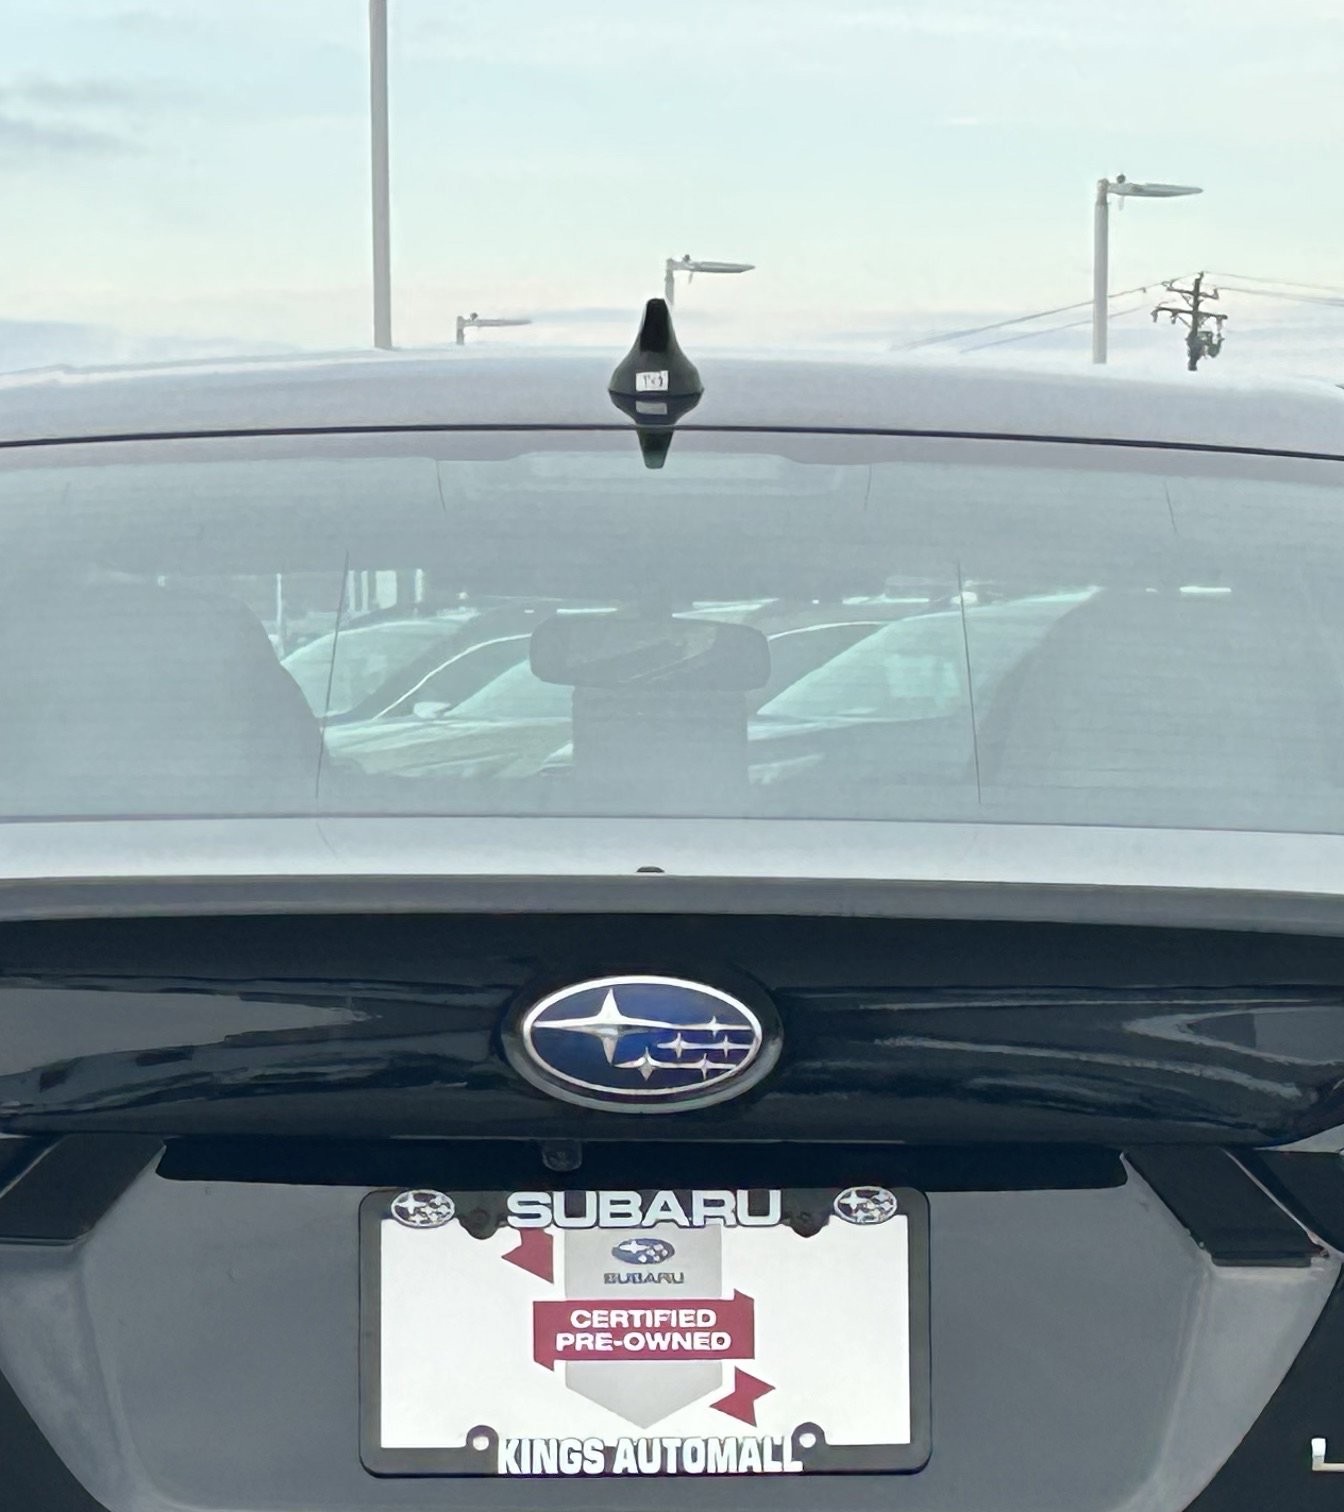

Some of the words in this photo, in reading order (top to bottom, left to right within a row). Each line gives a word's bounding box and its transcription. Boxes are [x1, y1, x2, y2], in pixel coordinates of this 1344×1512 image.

[506, 1189, 782, 1228] SUBARU
[604, 1272, 685, 1285] SUBARU
[570, 1309, 717, 1329] CERTIFIED
[556, 1332, 732, 1352] PRE-OWNED
[498, 1437, 606, 1475] KINGS
[612, 1436, 804, 1475] AUTOMALL
